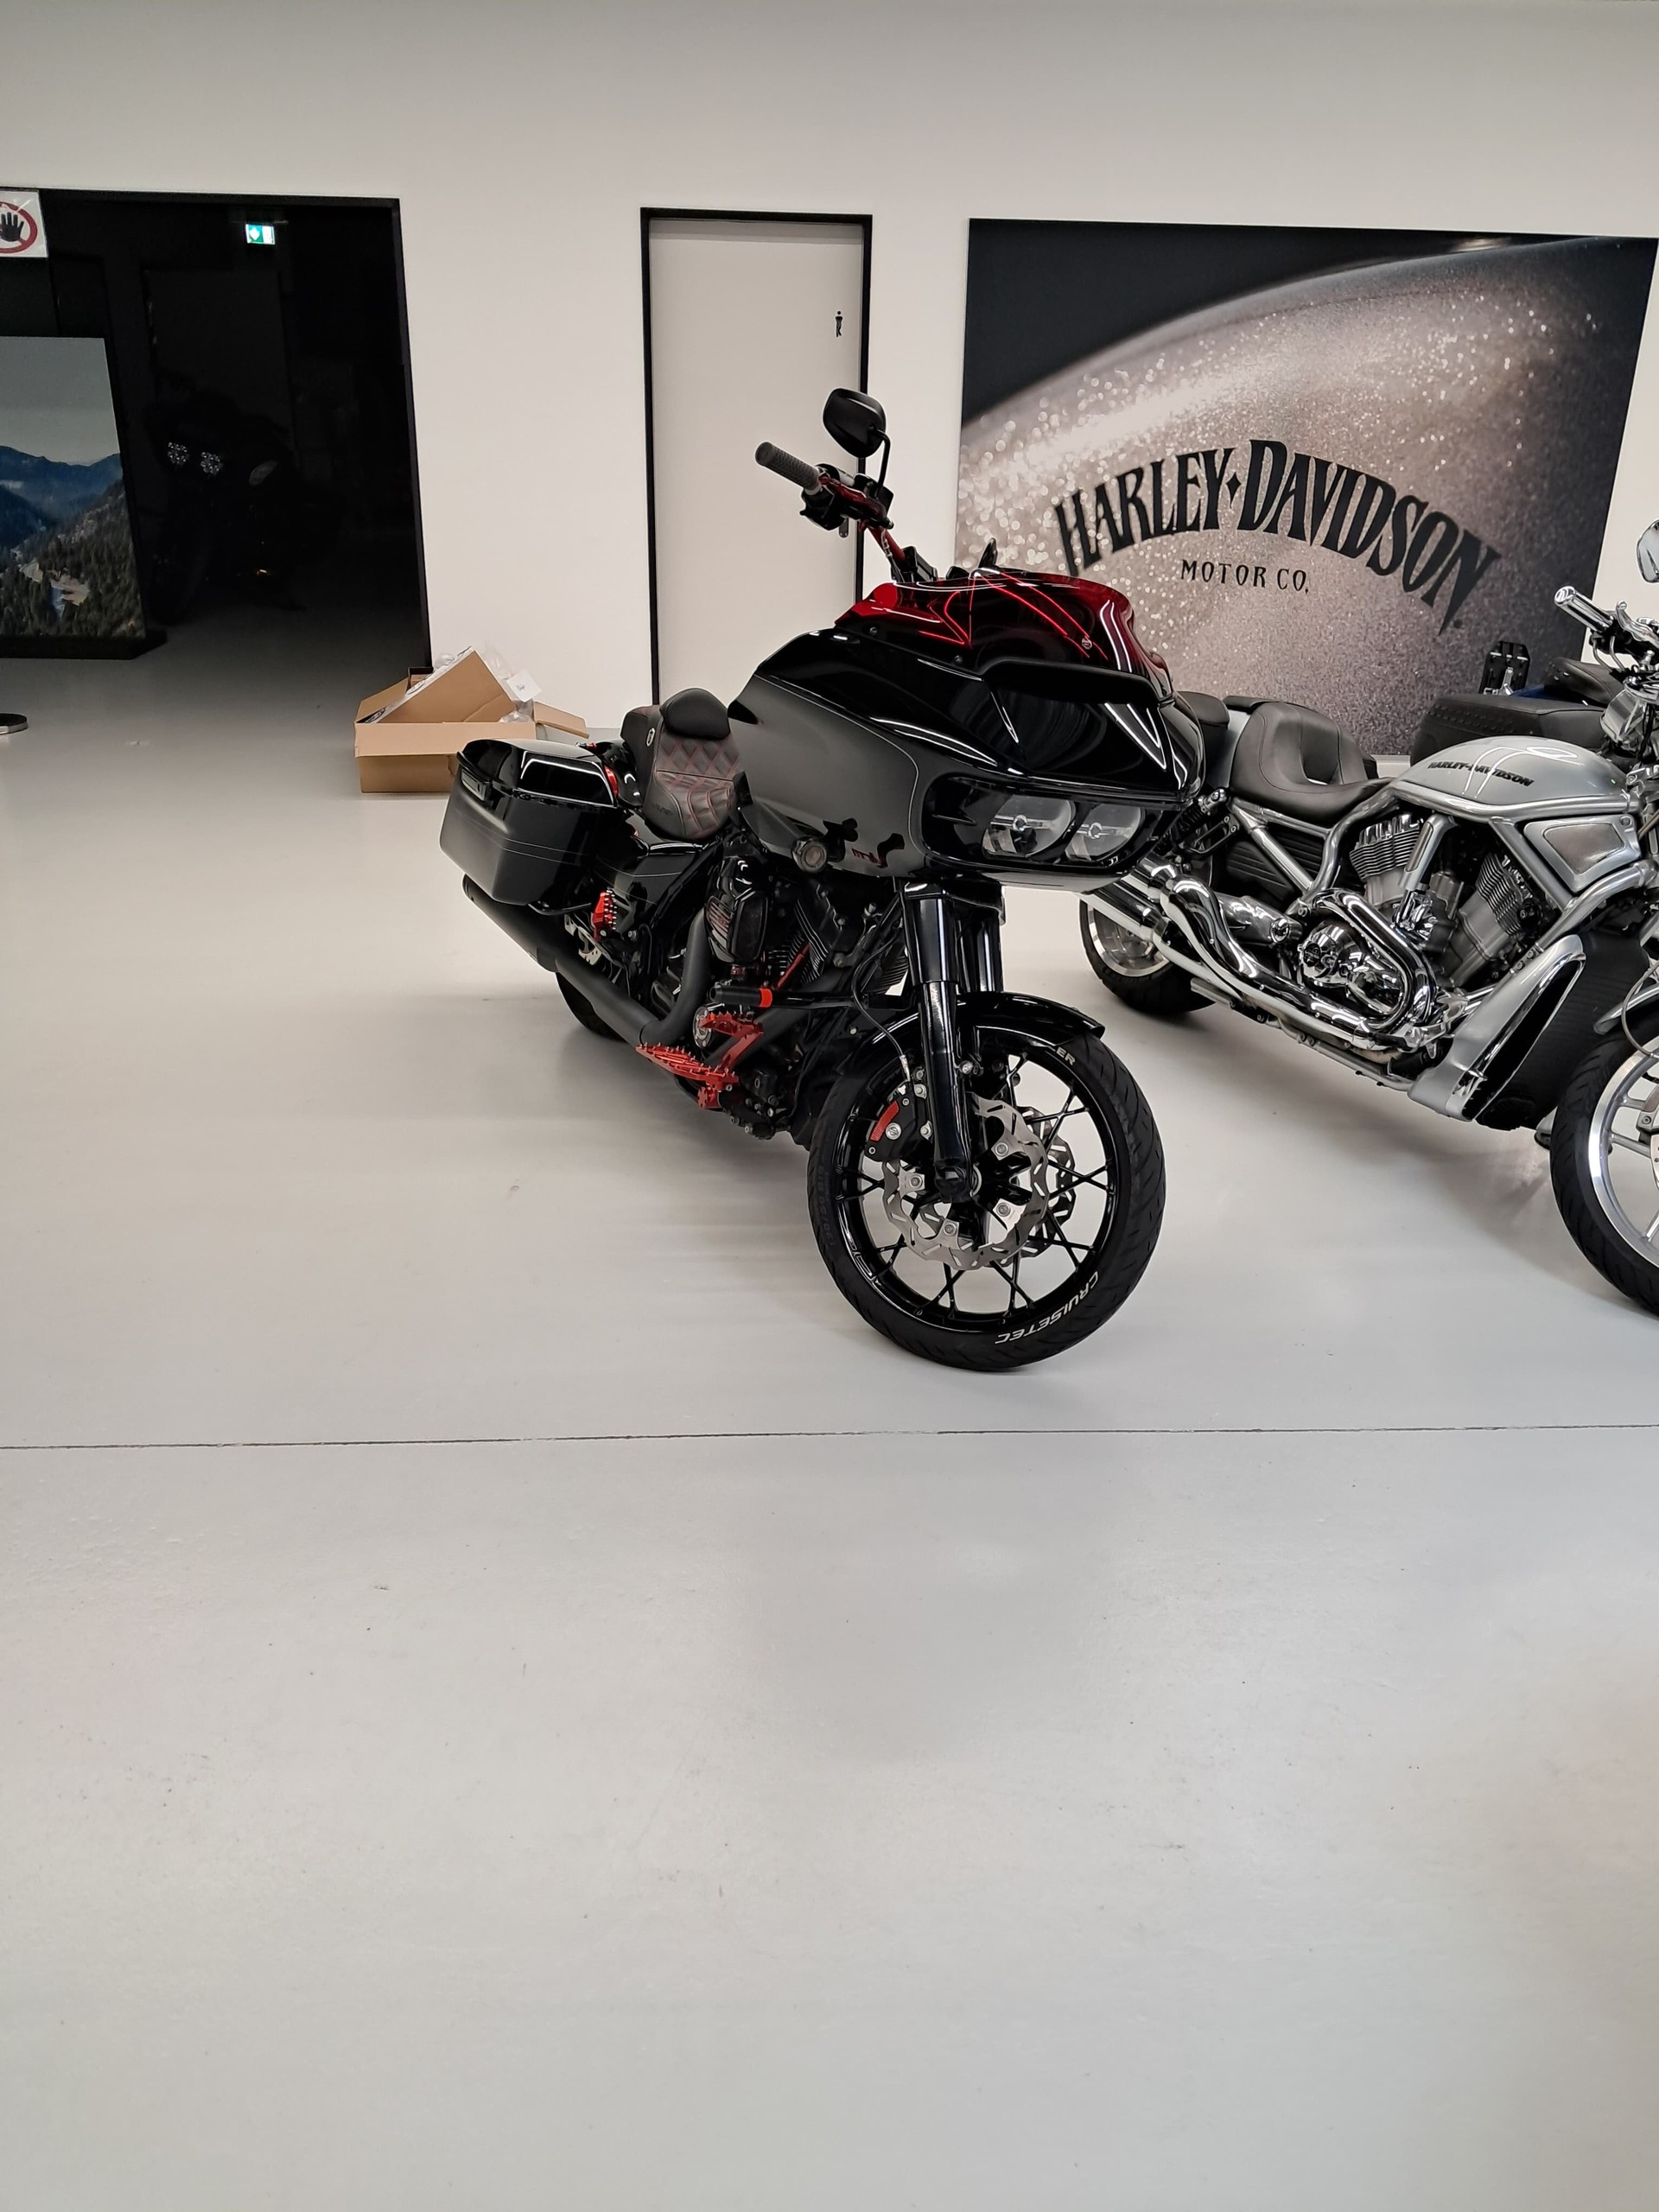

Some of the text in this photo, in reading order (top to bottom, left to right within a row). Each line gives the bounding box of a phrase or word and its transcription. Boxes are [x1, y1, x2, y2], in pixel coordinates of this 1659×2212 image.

[1180, 559, 1267, 588] MOTOR
[1427, 761, 1535, 787] HARLEY-DAVIDSON
[995, 1271, 1098, 1344] CRUISETEC
